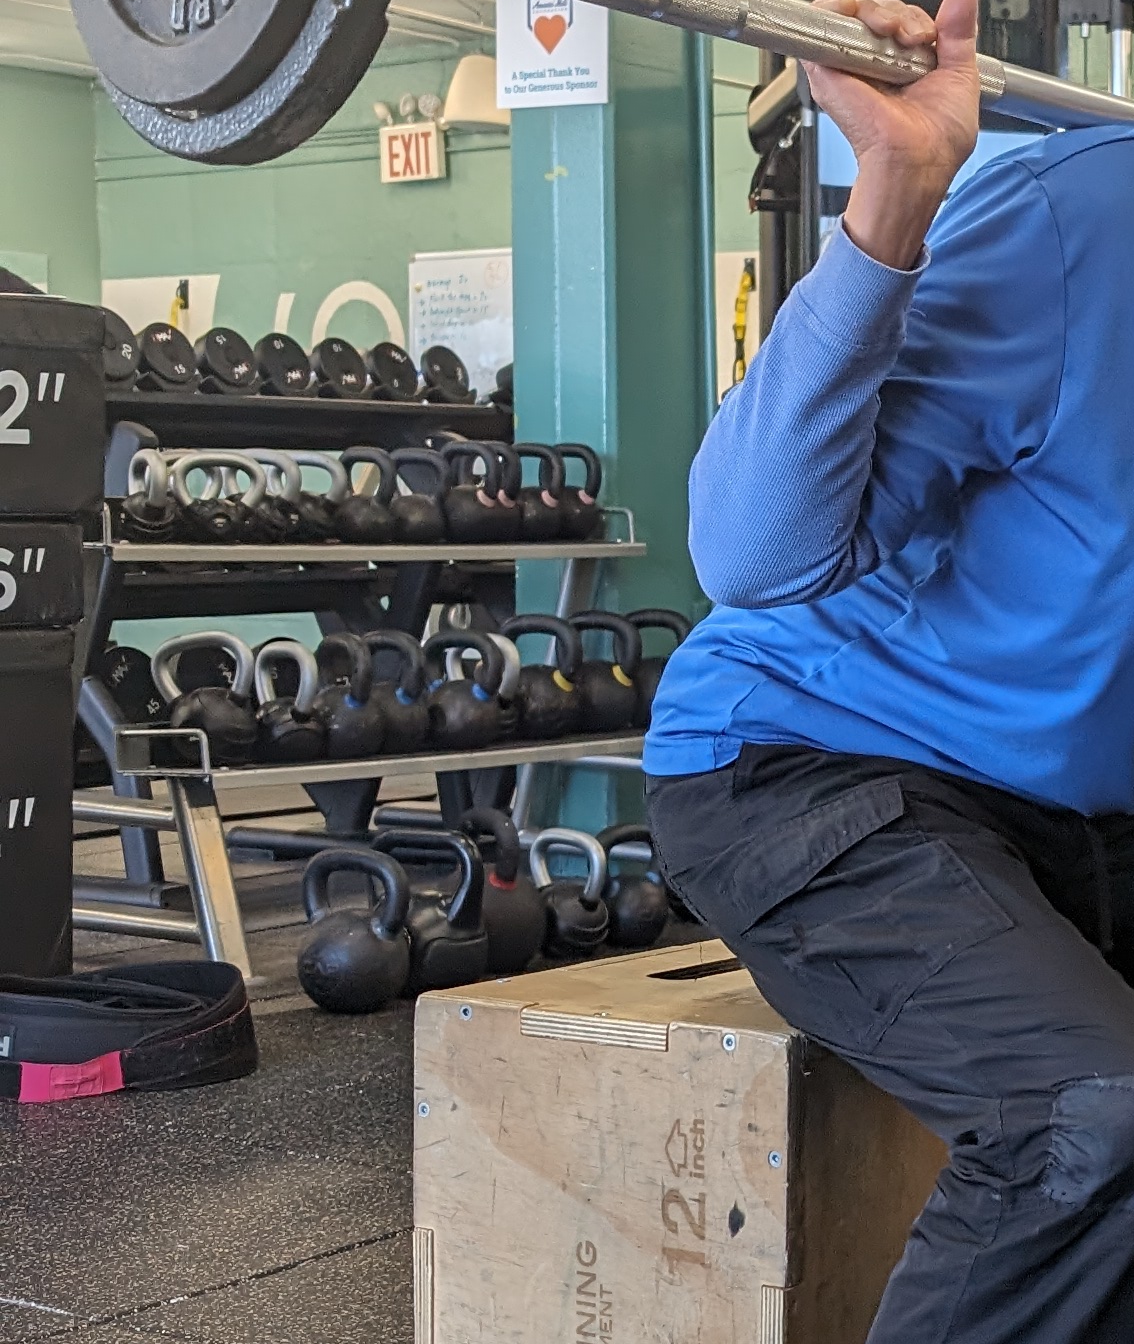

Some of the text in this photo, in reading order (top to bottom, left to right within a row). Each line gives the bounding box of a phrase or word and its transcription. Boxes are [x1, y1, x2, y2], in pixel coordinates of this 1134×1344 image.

[504, 80, 598, 94] to Our Generous Sponsor
[511, 66, 590, 82] A Special Thank You
[388, 131, 432, 178] EXIT
[661, 1118, 709, 1275] 12 inch
